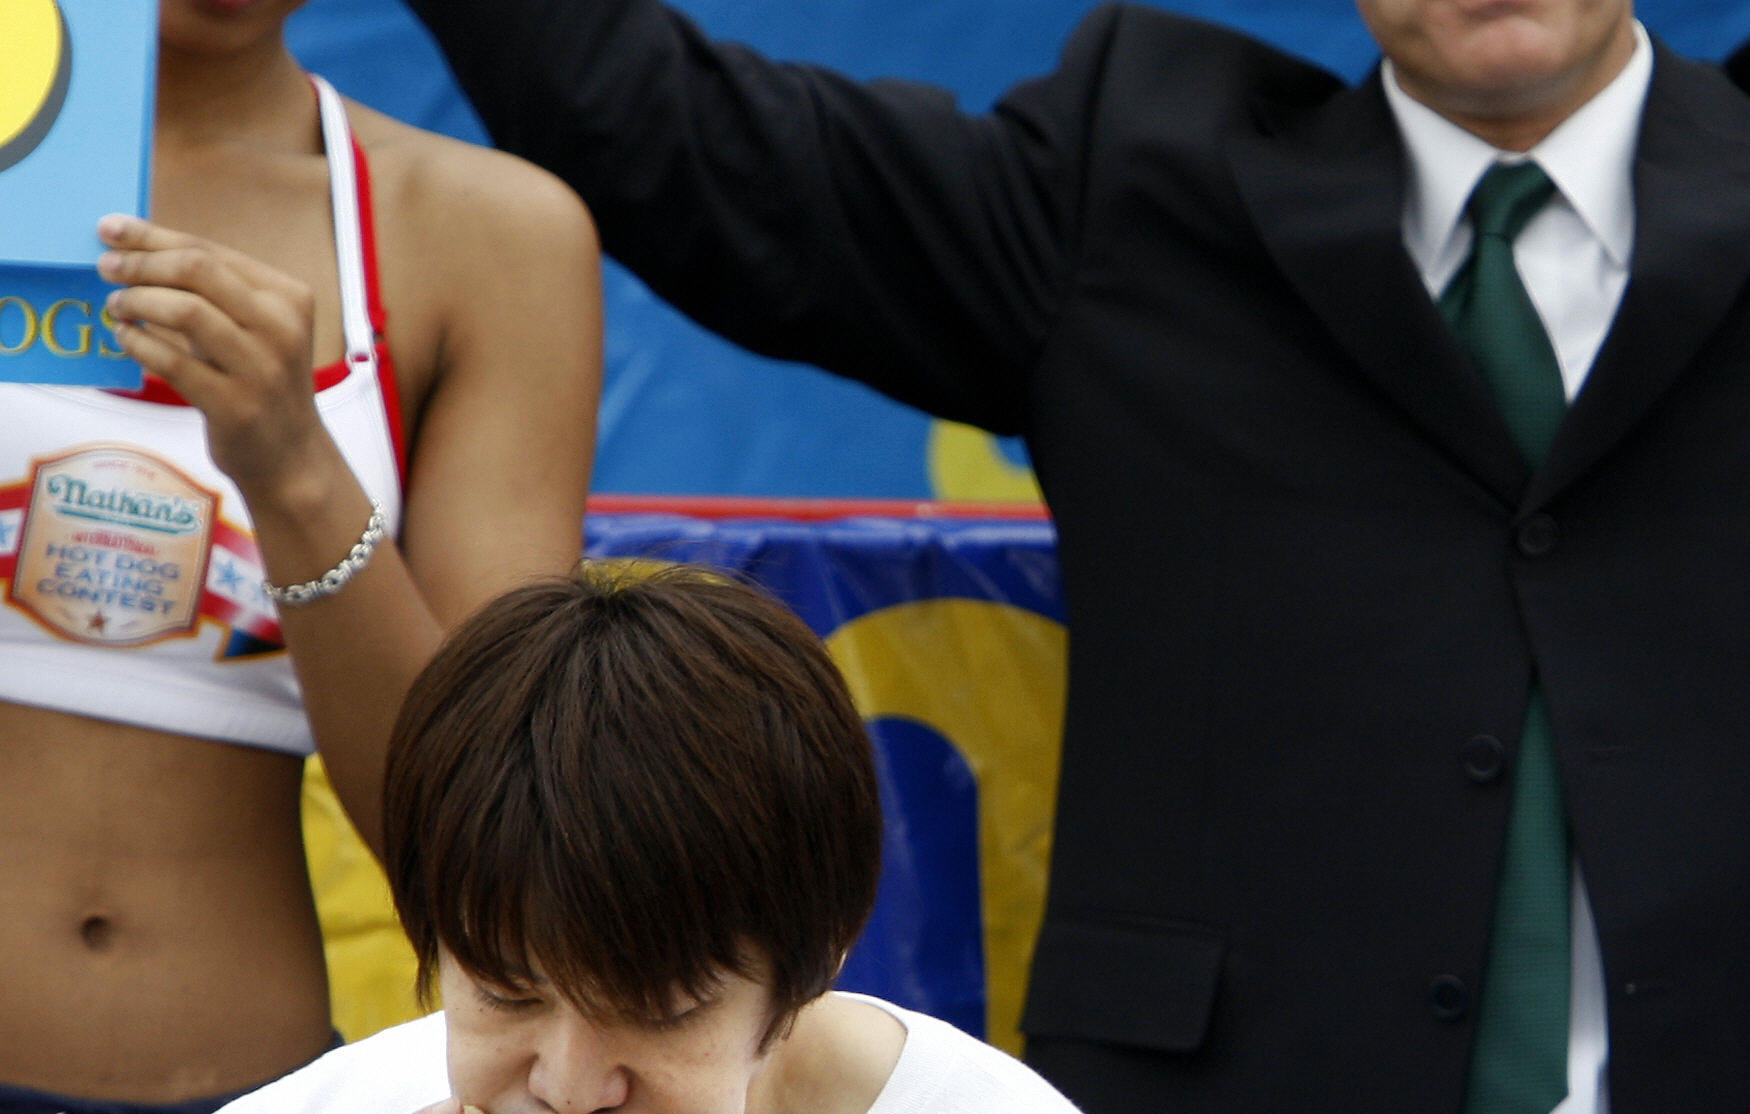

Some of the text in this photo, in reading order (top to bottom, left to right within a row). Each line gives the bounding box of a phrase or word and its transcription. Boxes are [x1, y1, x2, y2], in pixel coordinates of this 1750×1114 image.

[46, 543, 180, 580] HOT DOG
[55, 562, 164, 596] EATING
[36, 577, 180, 615] CONTEST
